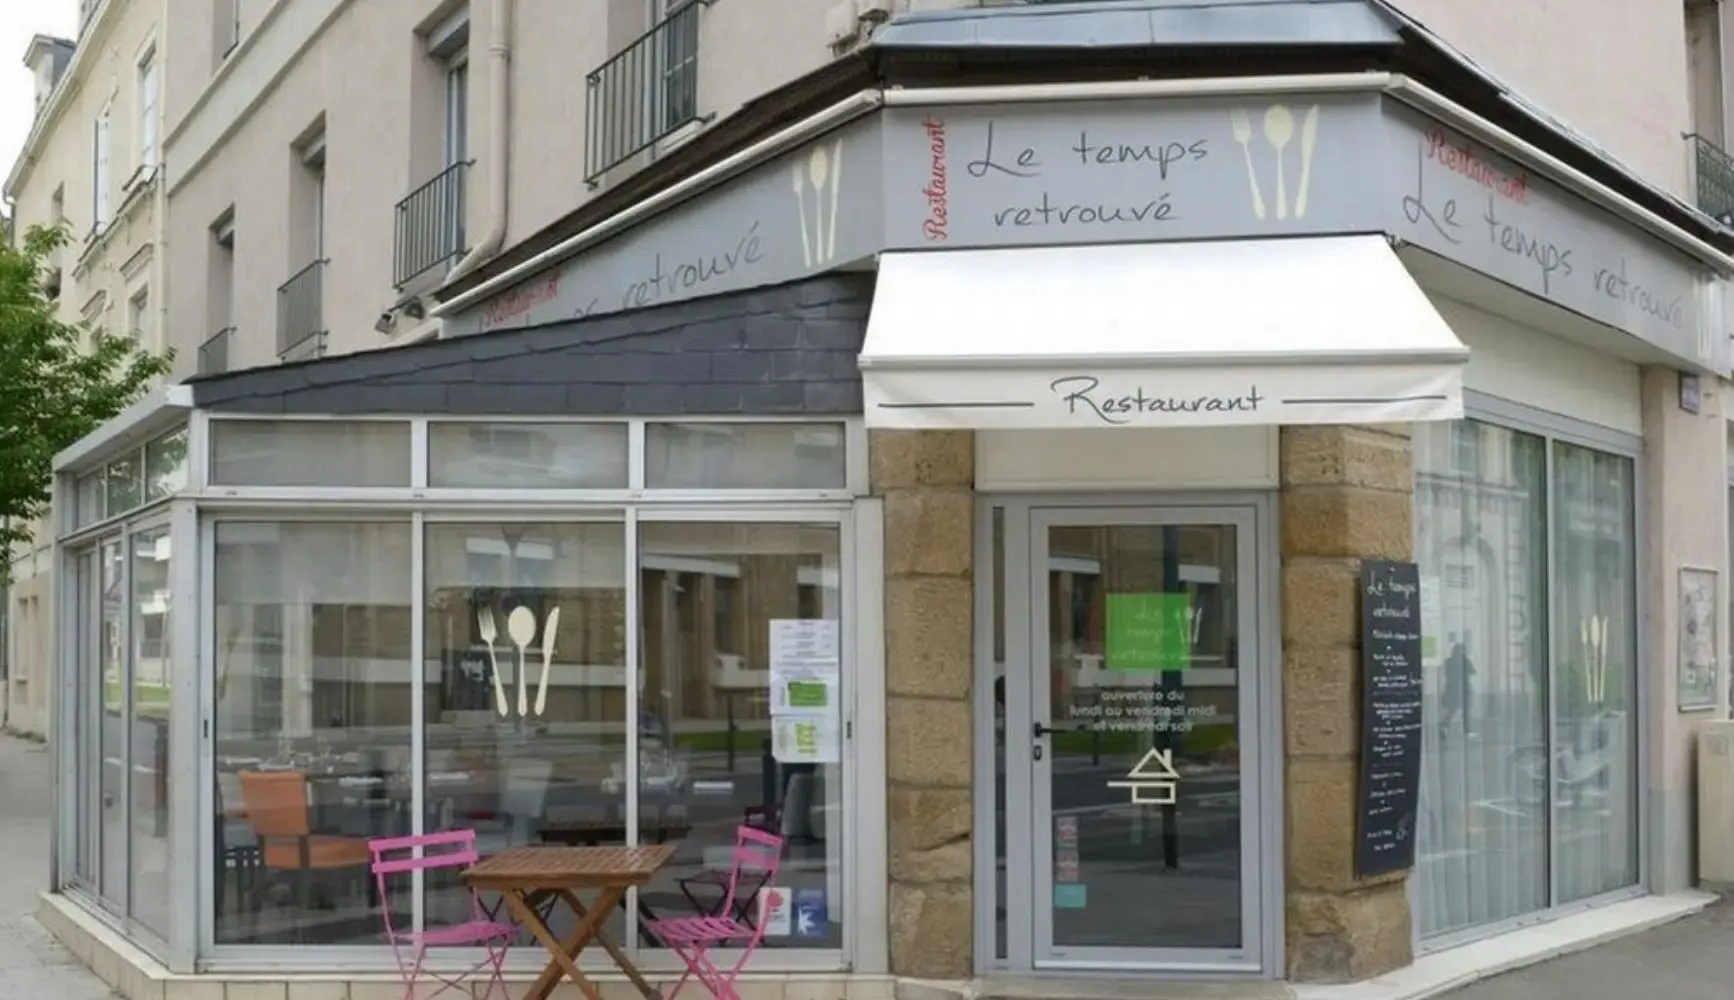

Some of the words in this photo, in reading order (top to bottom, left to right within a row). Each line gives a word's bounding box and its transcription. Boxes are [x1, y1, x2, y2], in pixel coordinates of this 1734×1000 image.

[922, 115, 948, 242] Restaurant
[967, 120, 1041, 178] Le
[1072, 131, 1209, 181] temps
[994, 192, 1181, 228] retrouvé
[1402, 140, 1465, 245] Le
[1484, 195, 1573, 296] temps
[1050, 375, 1265, 425] Restaurant
